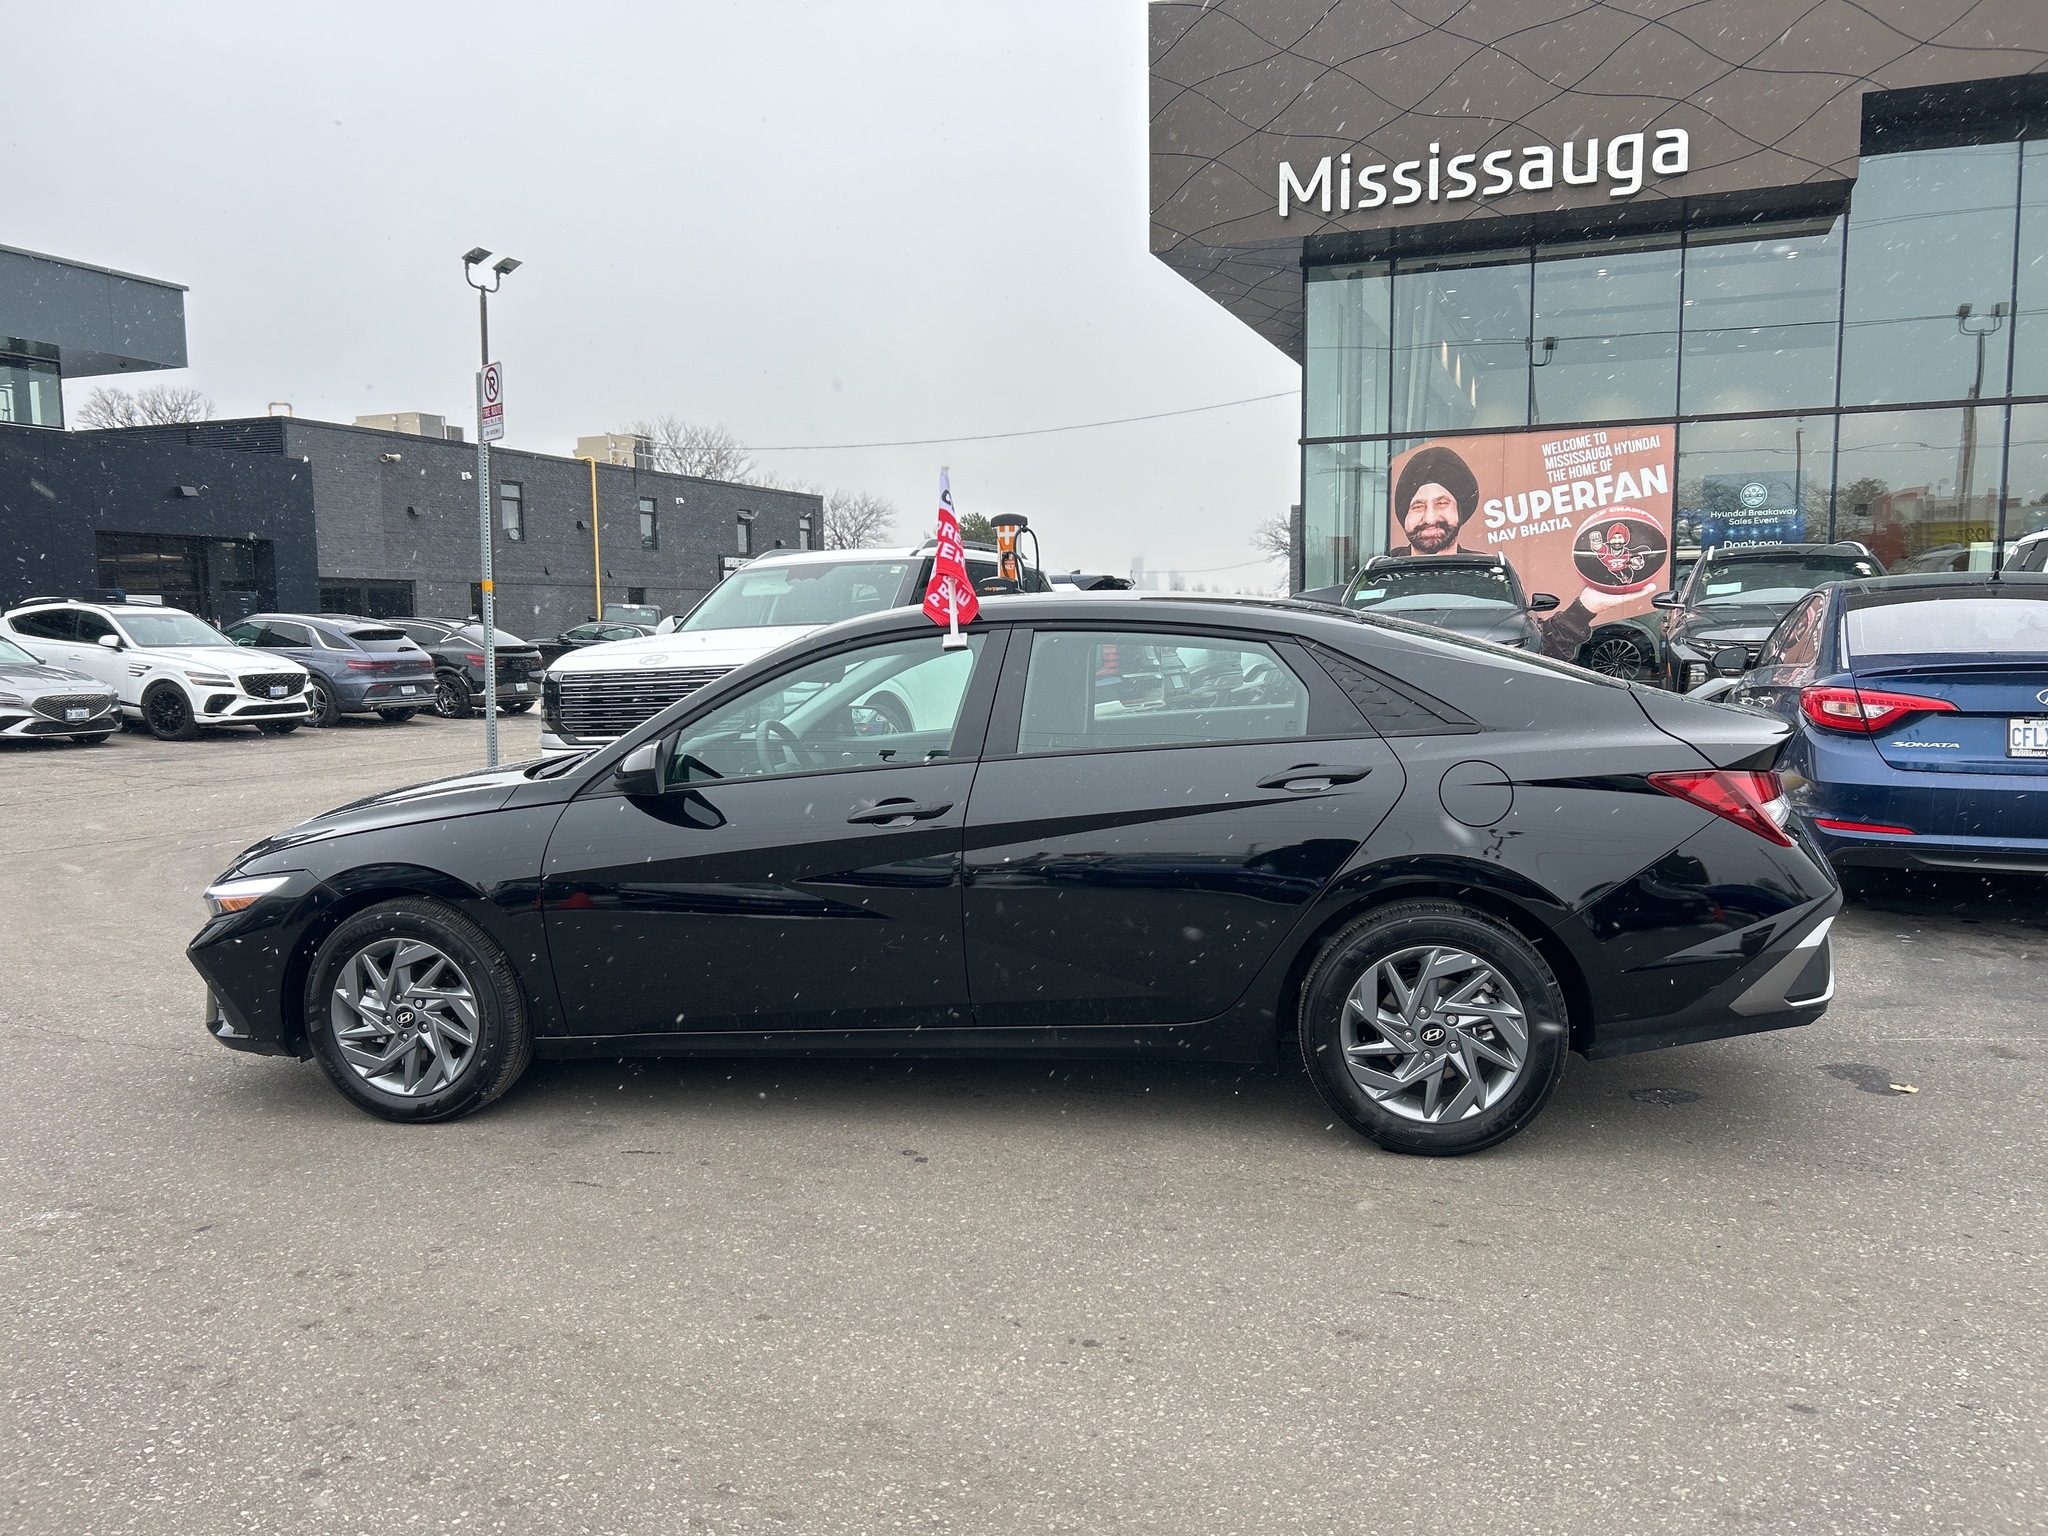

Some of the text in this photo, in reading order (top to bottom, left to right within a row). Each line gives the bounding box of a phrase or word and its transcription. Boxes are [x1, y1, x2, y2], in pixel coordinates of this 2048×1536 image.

[1278, 128, 1689, 217] Mississauga
[1541, 431, 1607, 456] WELCOME TO
[1544, 435, 1661, 470] MISSISSAUGA HYUNDAI
[1547, 458, 1613, 484] THE HOME OF
[1483, 464, 1669, 529] SUPERFAN
[1710, 508, 1798, 519] Hyundai Breakaway
[1728, 518, 1752, 526] Sales
[1487, 517, 1572, 545] NAV BHATIA
[1723, 540, 1757, 549] Don't
[1890, 741, 1961, 749] SONATA
